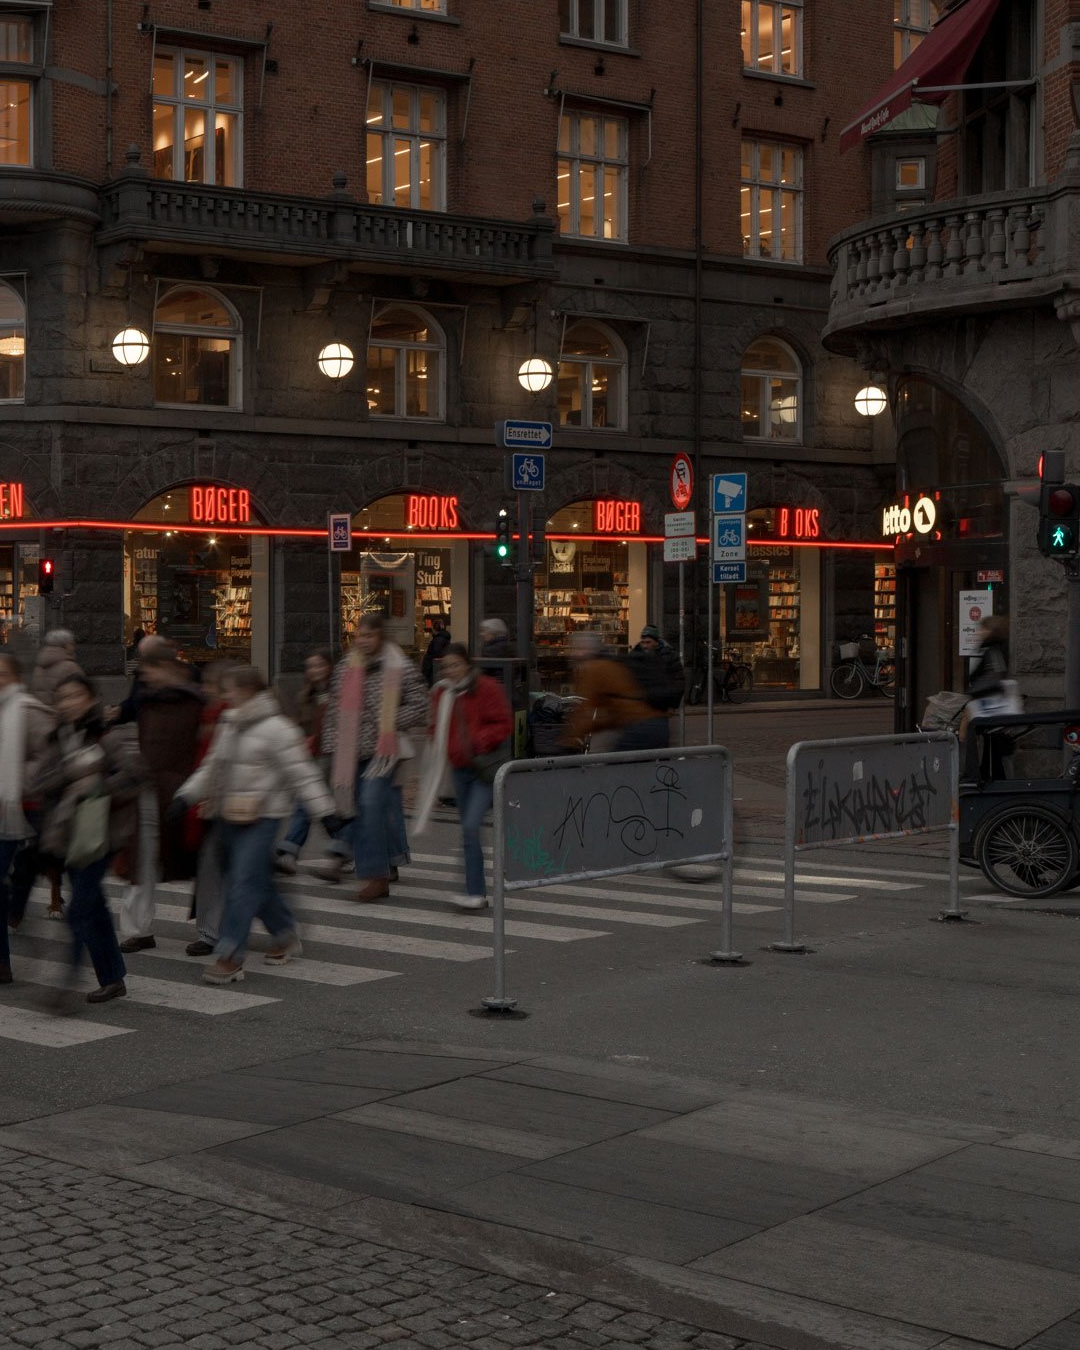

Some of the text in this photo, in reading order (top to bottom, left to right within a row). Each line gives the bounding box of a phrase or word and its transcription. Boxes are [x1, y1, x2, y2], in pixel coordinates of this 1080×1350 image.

[508, 428, 542, 440] Ensrettet
[193, 486, 249, 523] BØGER
[408, 495, 458, 529] BOOKS
[596, 500, 641, 532] BØGER
[780, 508, 819, 538] BOKS
[417, 552, 441, 570] Ting
[747, 546, 790, 557] lassics
[416, 570, 444, 586] Stuff
